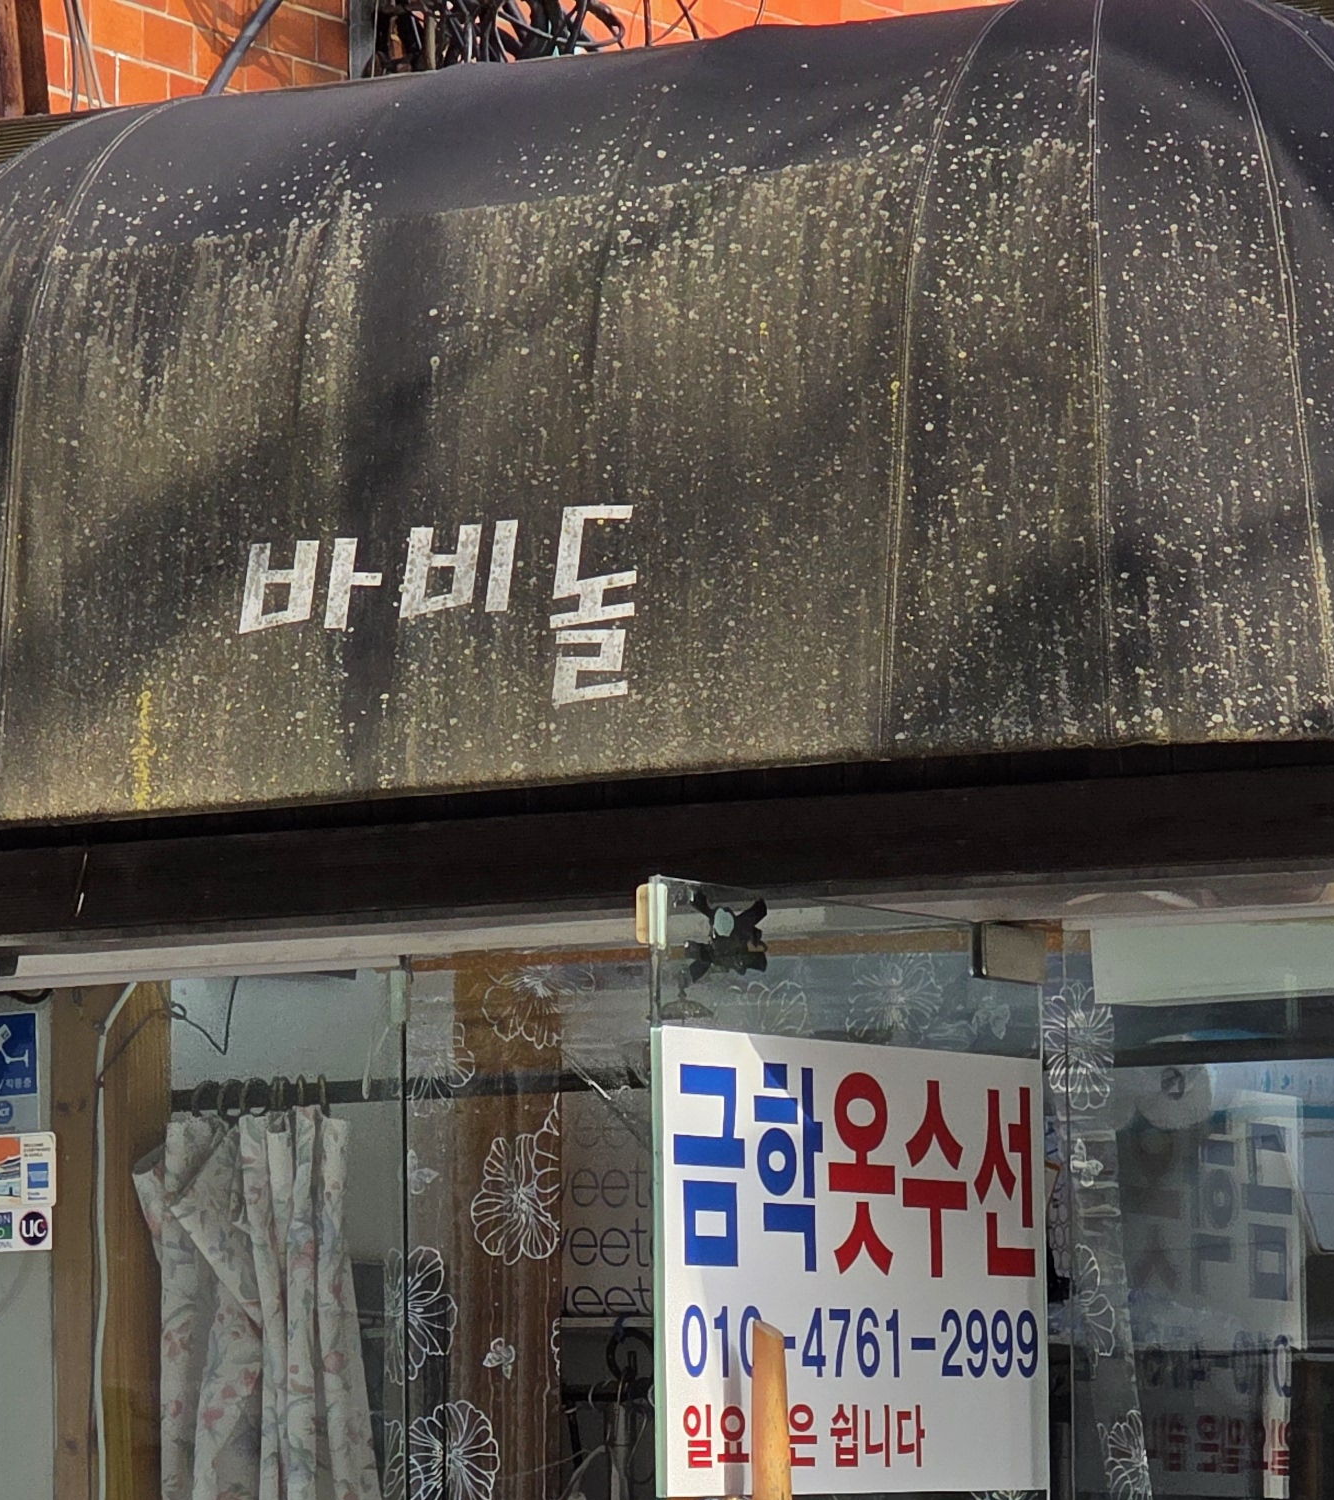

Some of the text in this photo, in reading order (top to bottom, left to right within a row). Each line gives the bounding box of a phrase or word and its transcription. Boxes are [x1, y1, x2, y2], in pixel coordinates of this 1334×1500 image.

[238, 503, 638, 709] 바비돌
[682, 1403, 927, 1469] 일요은 쉽니다
